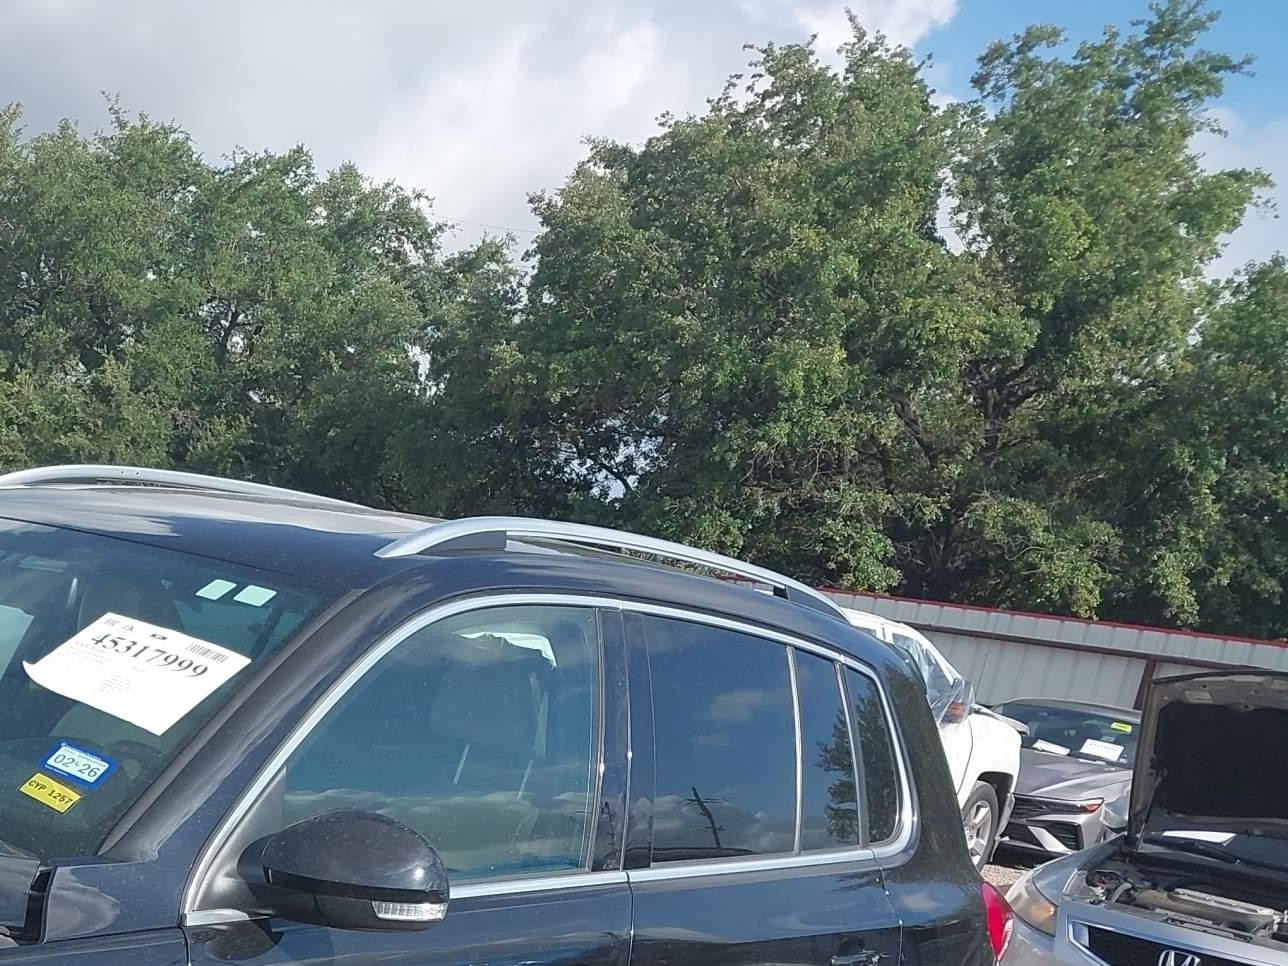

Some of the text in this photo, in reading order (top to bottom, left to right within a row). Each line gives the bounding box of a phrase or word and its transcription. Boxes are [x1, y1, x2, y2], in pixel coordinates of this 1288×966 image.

[91, 633, 209, 678] 45317999
[78, 763, 100, 778] 26
[28, 780, 73, 804] CYP 1257
